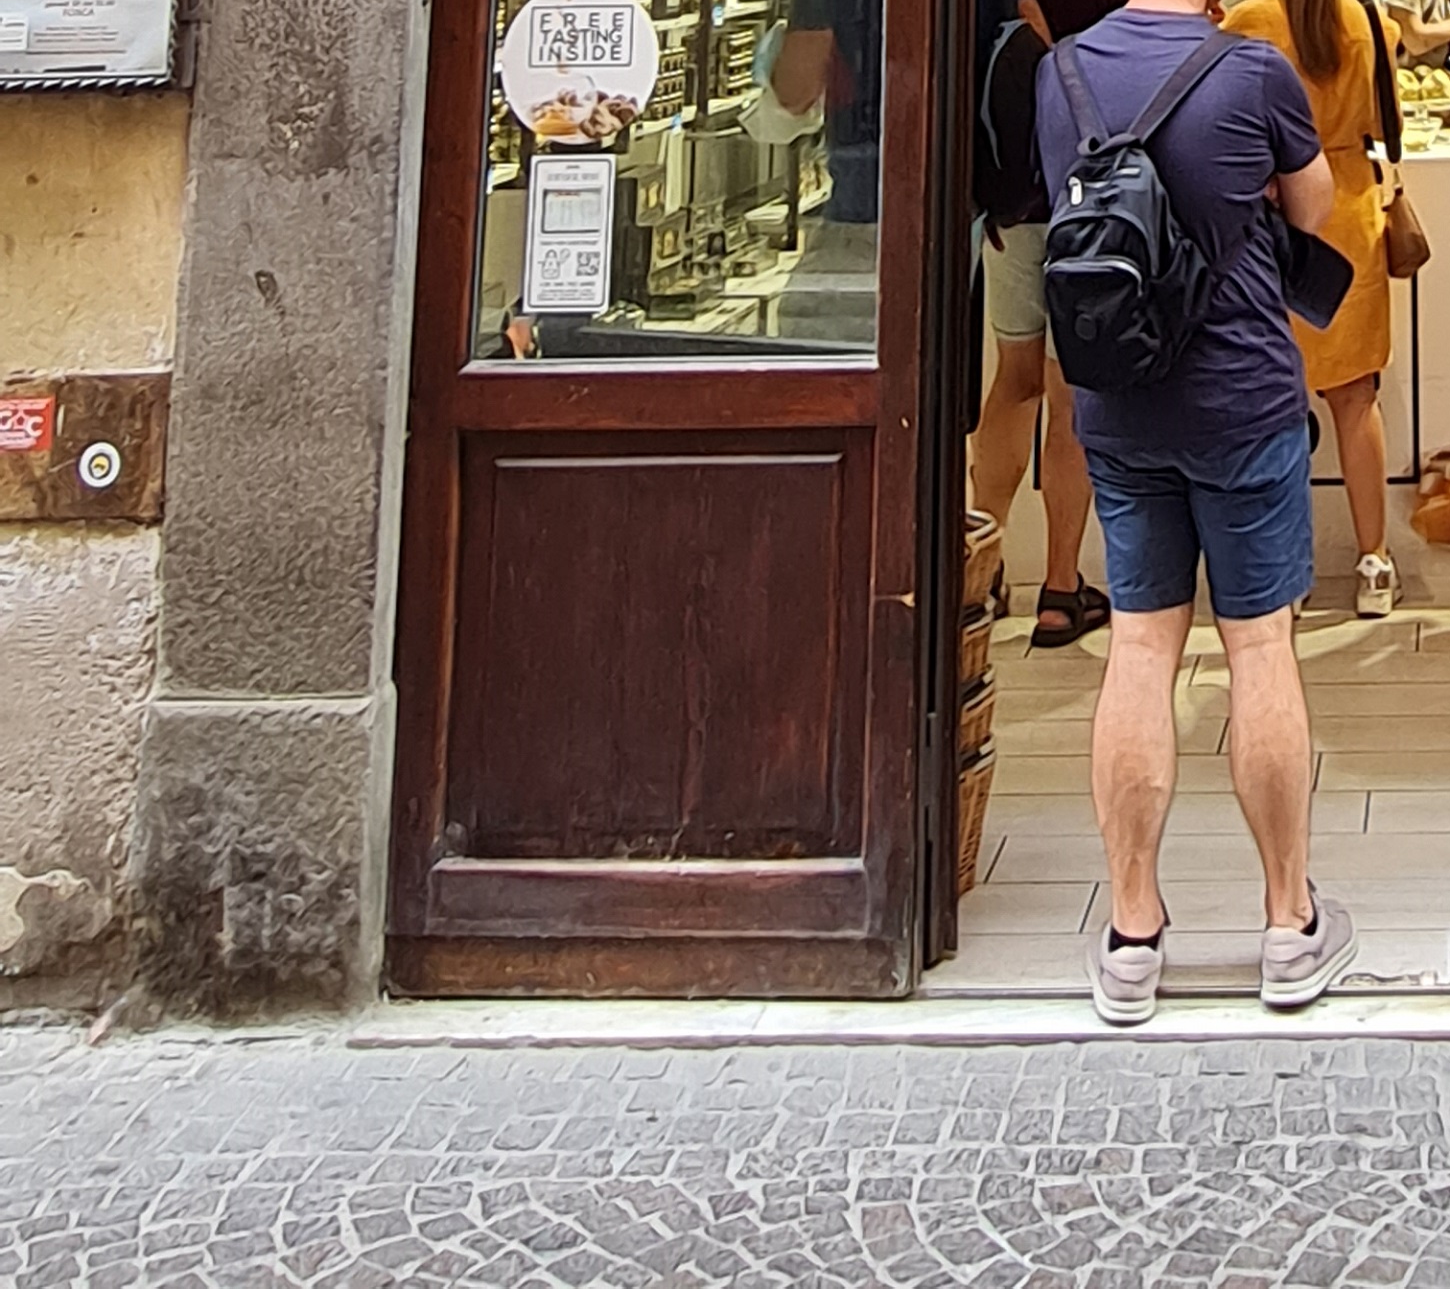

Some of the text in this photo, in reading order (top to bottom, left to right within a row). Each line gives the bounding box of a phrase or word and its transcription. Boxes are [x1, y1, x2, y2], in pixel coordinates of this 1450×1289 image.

[540, 11, 625, 30] FREE
[540, 28, 624, 45] TASTING
[538, 44, 622, 62] INSIDE
